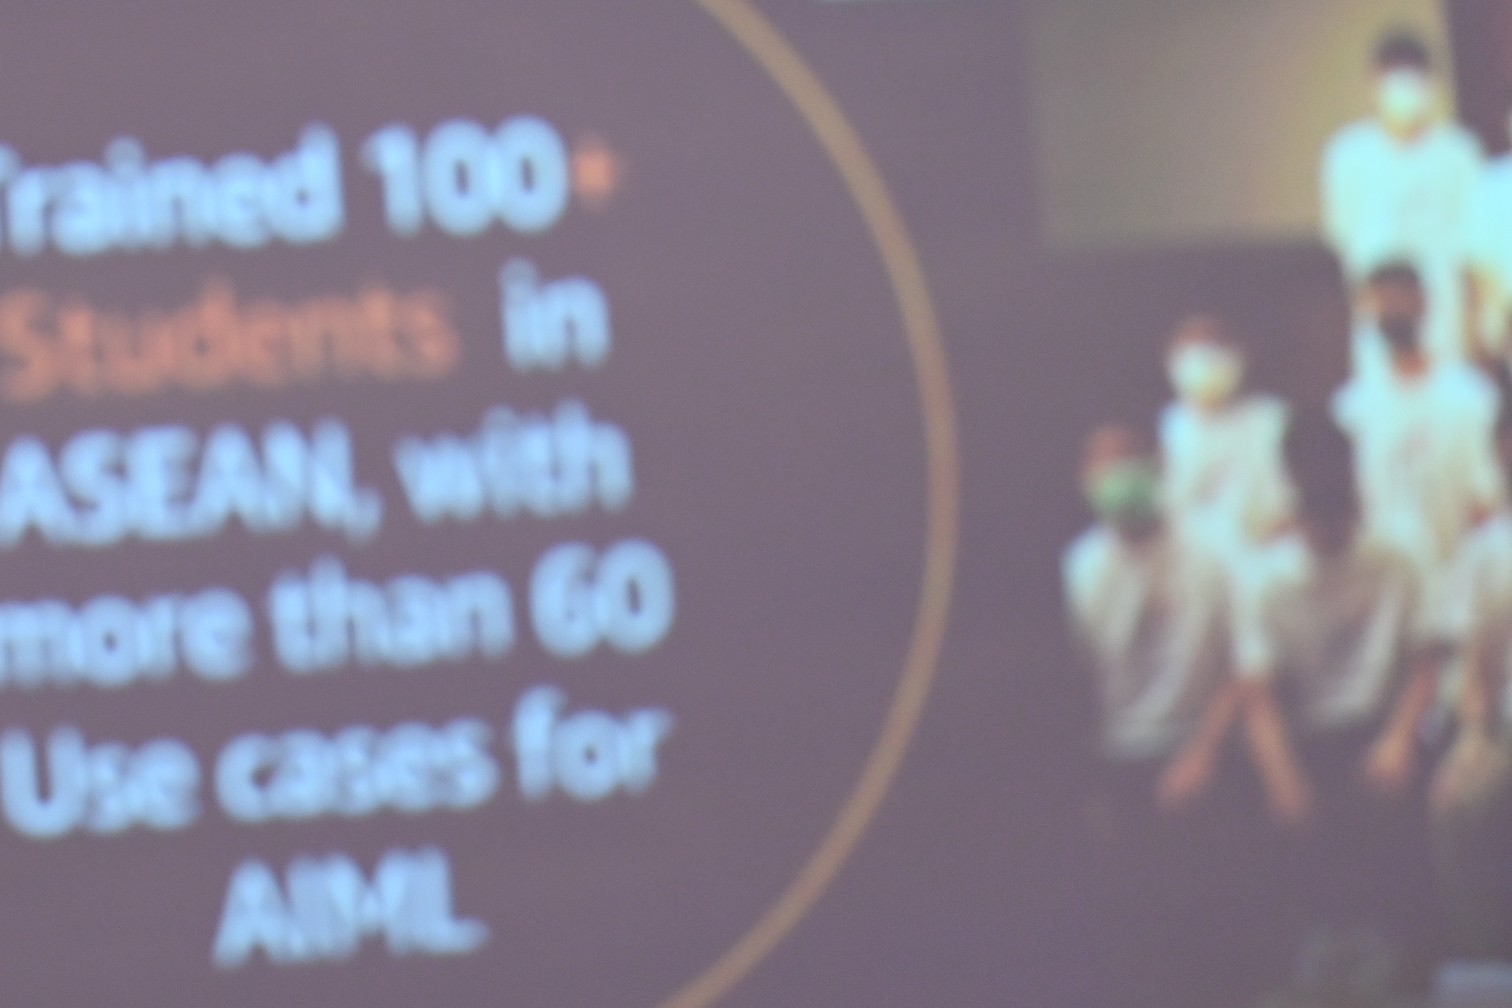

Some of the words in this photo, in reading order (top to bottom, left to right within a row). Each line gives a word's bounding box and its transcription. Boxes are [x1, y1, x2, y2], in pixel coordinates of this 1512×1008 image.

[499, 257, 611, 370] in
[394, 400, 633, 521] with
[268, 556, 515, 672] than
[528, 538, 676, 657] 60
[214, 717, 499, 822] cases
[511, 684, 672, 801] for
[213, 847, 488, 967] AIML
